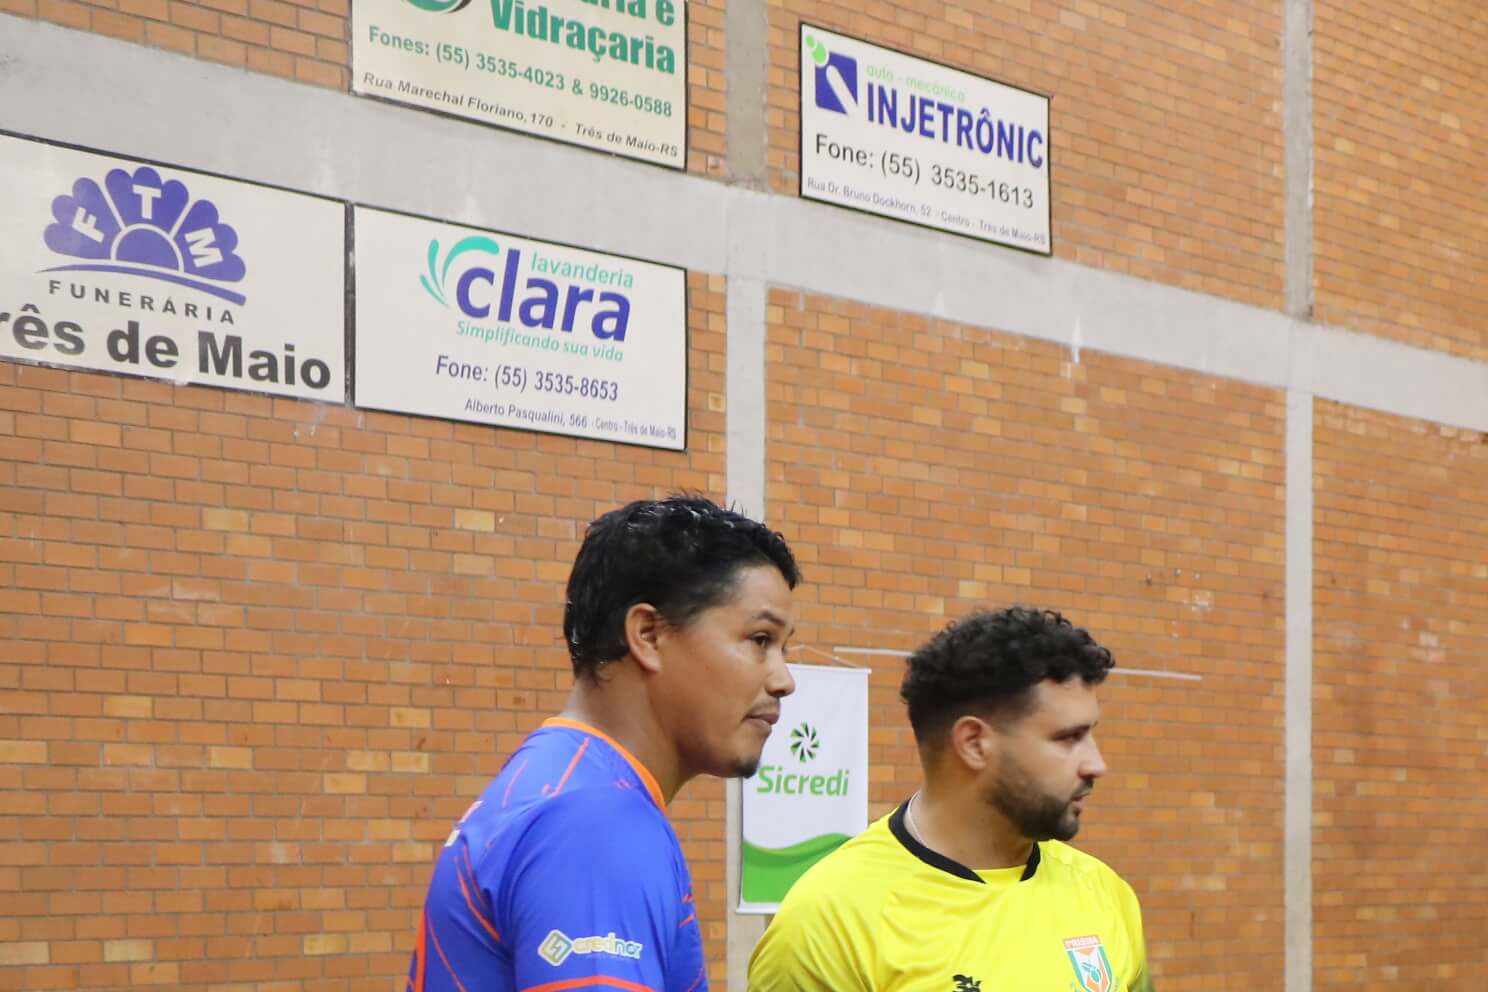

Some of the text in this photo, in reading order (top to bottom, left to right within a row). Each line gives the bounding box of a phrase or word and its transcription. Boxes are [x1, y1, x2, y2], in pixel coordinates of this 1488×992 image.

[490, 0, 675, 75] Vidraçaria
[369, 25, 673, 118] Fones: (55) 3535-4023 & 9926-0588
[866, 64, 894, 81] auto
[363, 72, 393, 90] Rua
[398, 80, 464, 106] Marechal
[467, 96, 528, 122] Floriano,
[531, 112, 553, 128] 170
[606, 132, 622, 145] de
[626, 135, 678, 158] Maio-RS
[867, 82, 1044, 170] INJETRÔNIC
[808, 177, 826, 192] Rua
[843, 185, 872, 202] Bruno
[816, 133, 1034, 209] Fone: (55) 3535-1613
[531, 252, 634, 290] lavanderia
[49, 280, 235, 325] FUNERÁRIA
[456, 248, 631, 343] clara
[106, 320, 180, 369] de
[198, 330, 331, 390] Maio
[456, 319, 624, 362] Simplificando sua vida
[435, 355, 619, 401] Fone: (55) 3535-8653
[464, 398, 505, 417] Alberto
[508, 403, 566, 427] Pasqualini,
[568, 413, 588, 429] 566
[757, 765, 849, 797] Sicredi
